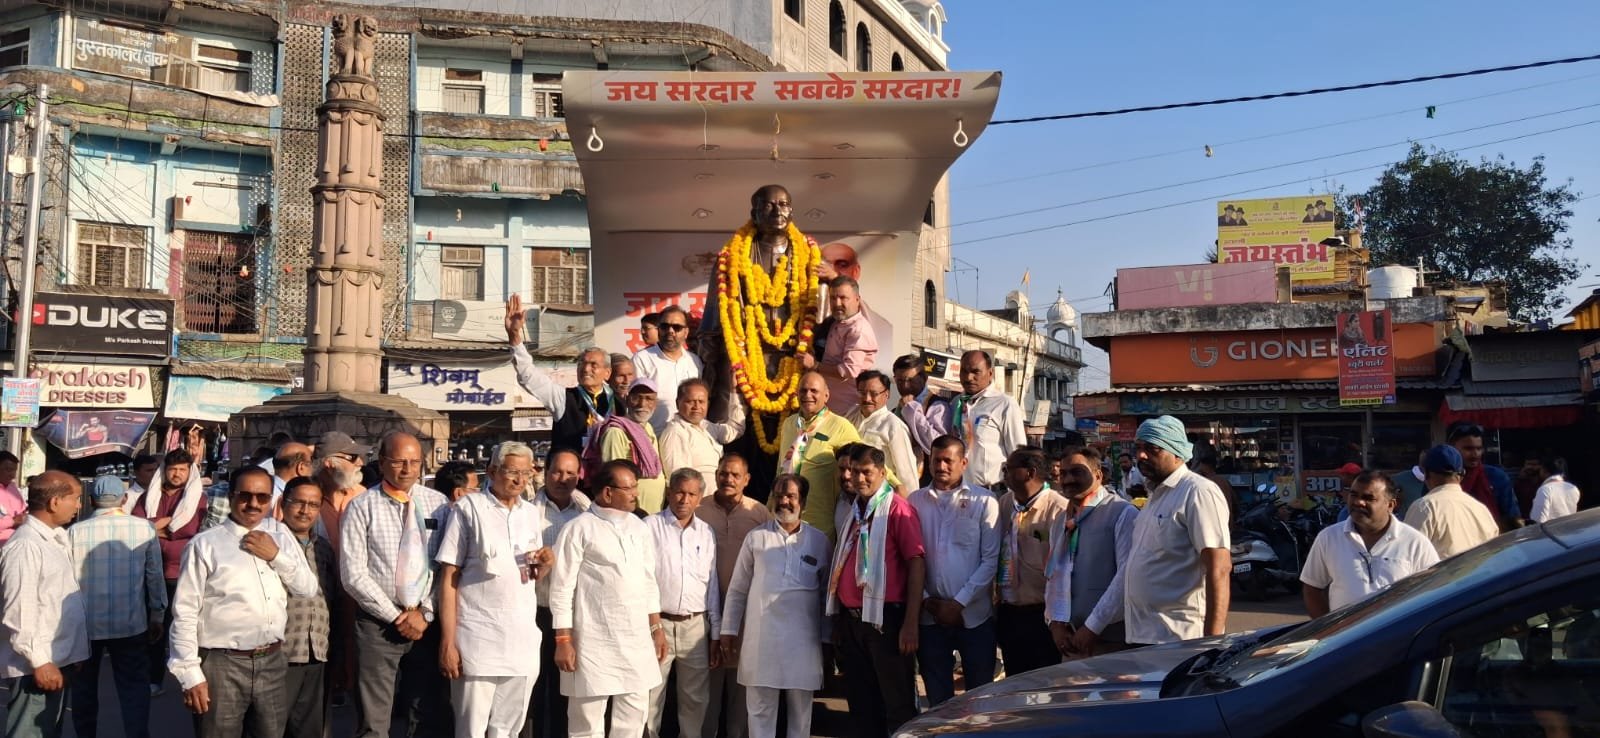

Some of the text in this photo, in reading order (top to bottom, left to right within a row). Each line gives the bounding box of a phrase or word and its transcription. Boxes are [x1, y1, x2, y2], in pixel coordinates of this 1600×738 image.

[604, 72, 962, 103] जय सरदार सबके सरदार!
[48, 304, 168, 331] DUKE
[28, 366, 147, 390] Prakash
[48, 389, 128, 404] DRESSES
